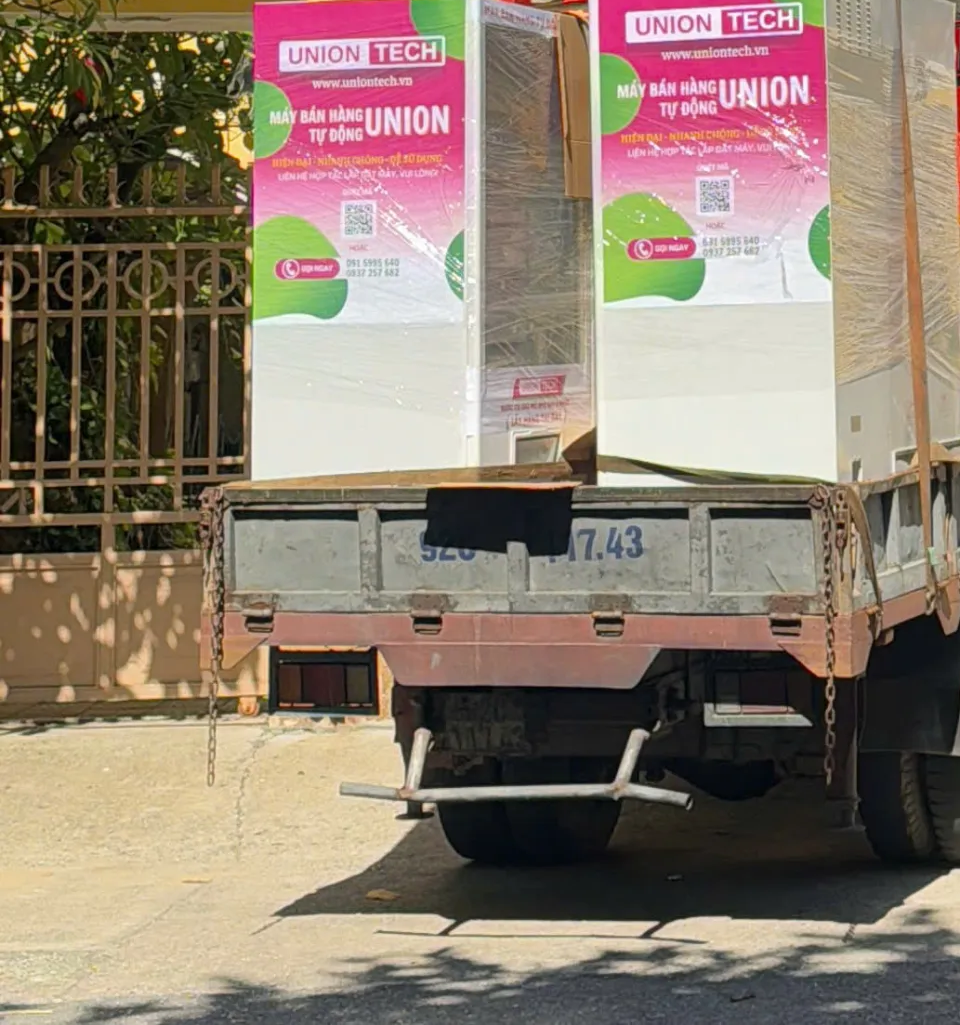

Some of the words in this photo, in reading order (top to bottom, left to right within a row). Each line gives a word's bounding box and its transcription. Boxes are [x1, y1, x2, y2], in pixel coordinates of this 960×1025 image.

[635, 13, 713, 37] UNION
[727, 8, 795, 32] TECH
[289, 45, 361, 65] UNION
[374, 41, 437, 63] TECH
[661, 44, 770, 61] www.uniontech.vn
[312, 76, 413, 89] www.uniontech.vn
[616, 78, 646, 99] MÁY
[649, 77, 677, 98] BÁN
[680, 75, 717, 95] HÀNG
[718, 74, 809, 110] UNION
[269, 106, 297, 125] MÁY
[301, 105, 326, 124] BÁN
[330, 104, 363, 123] HÀNG
[659, 101, 678, 120] TỰ
[681, 96, 717, 119] ĐỘNG
[365, 105, 450, 137] UNION
[309, 128, 328, 146] TỰ
[330, 125, 363, 145] ĐỘNG
